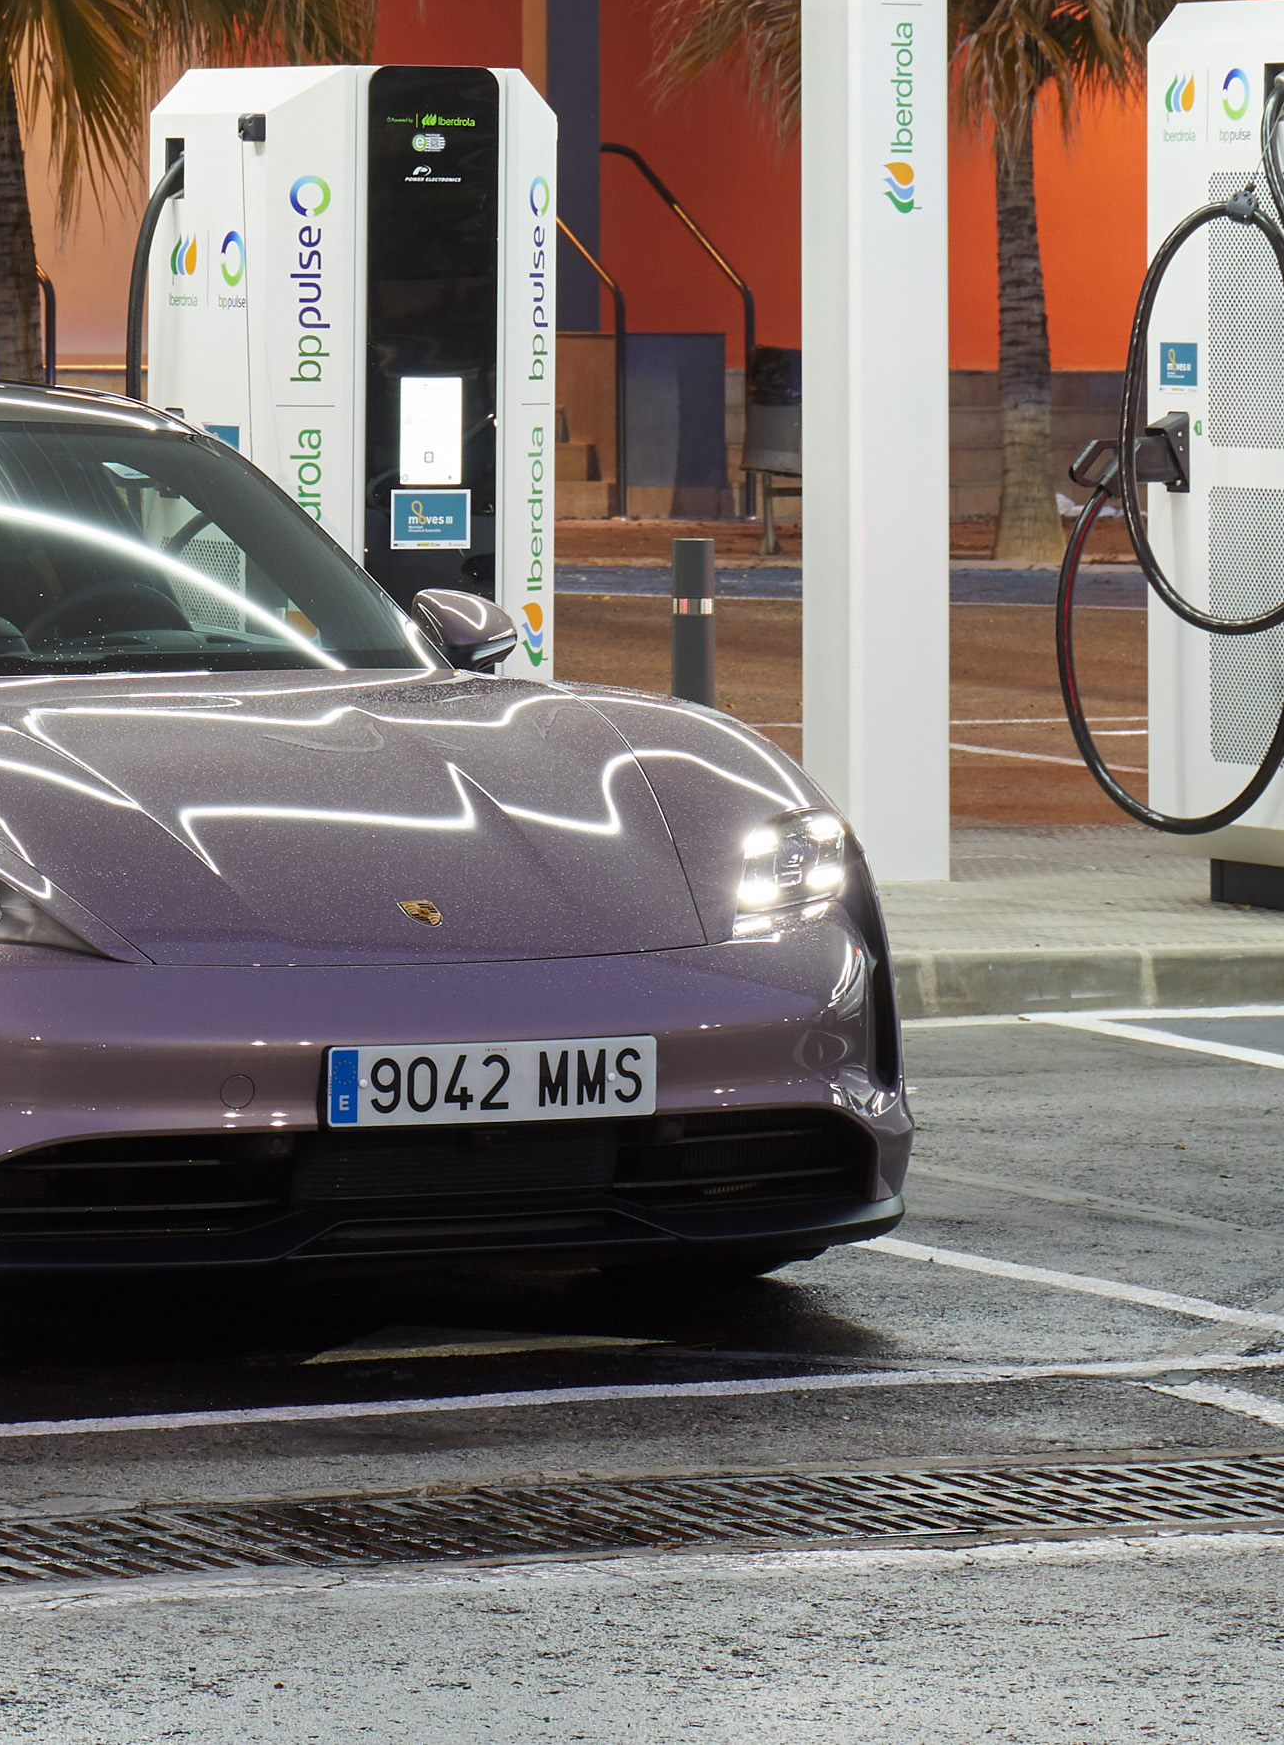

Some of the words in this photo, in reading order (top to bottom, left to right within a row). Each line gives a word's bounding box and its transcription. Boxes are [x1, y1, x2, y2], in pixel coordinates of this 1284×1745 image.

[891, 23, 913, 153] Iberdrola
[438, 117, 475, 127] Iberdrola
[527, 426, 544, 592] Iberdrola
[339, 1094, 350, 1111] E
[370, 1054, 511, 1114] 9042
[538, 1047, 643, 1108] MMS
